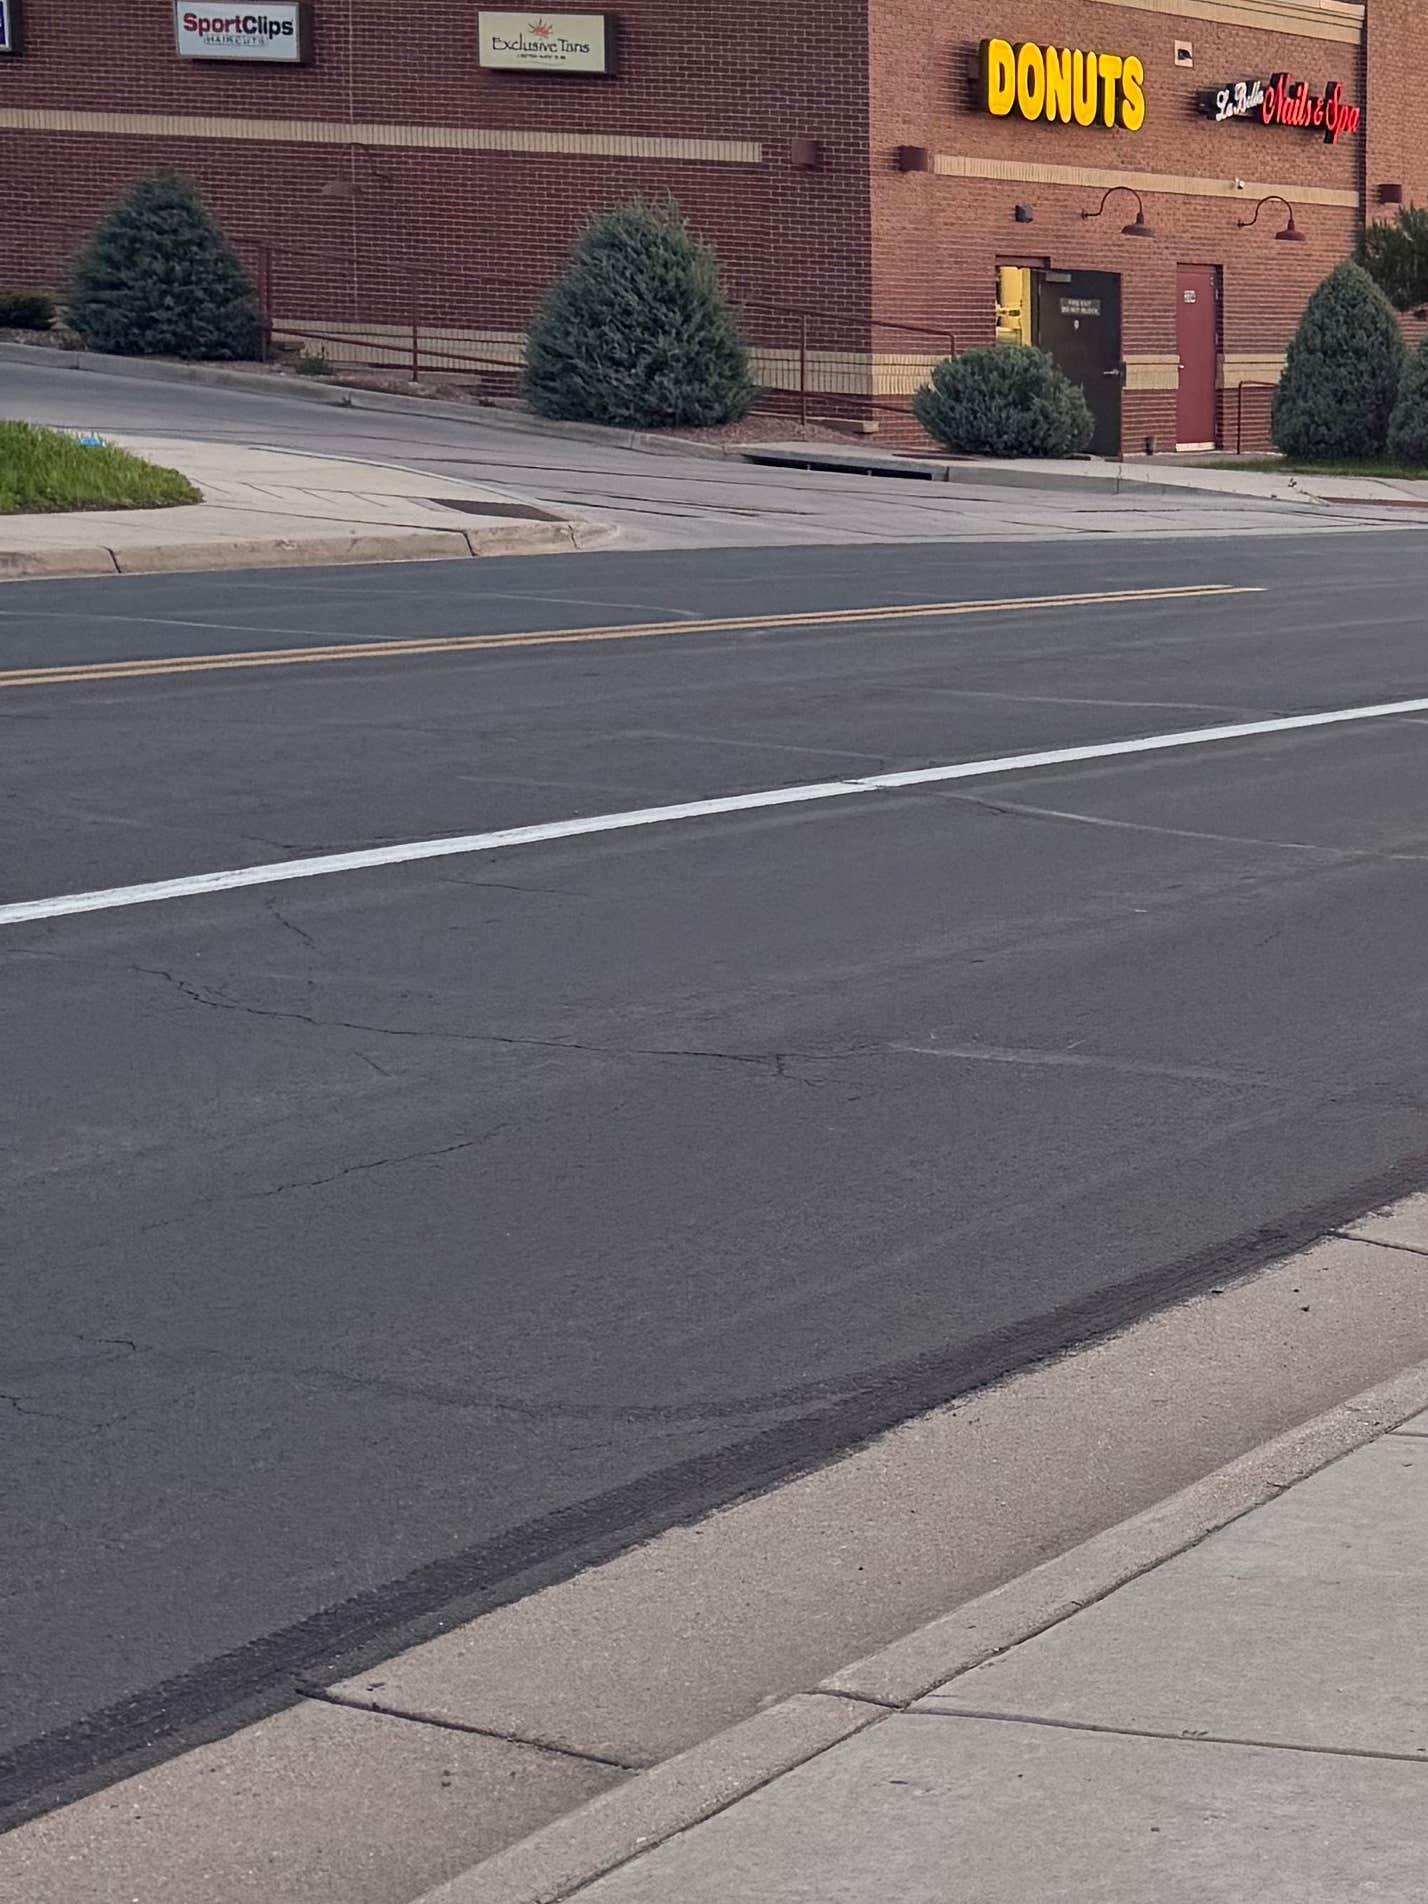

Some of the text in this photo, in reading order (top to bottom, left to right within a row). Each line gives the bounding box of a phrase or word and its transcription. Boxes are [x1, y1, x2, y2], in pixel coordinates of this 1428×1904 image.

[988, 38, 1146, 131] DONUTS
[1263, 73, 1312, 126] Nails
[1326, 82, 1360, 145] Spa
